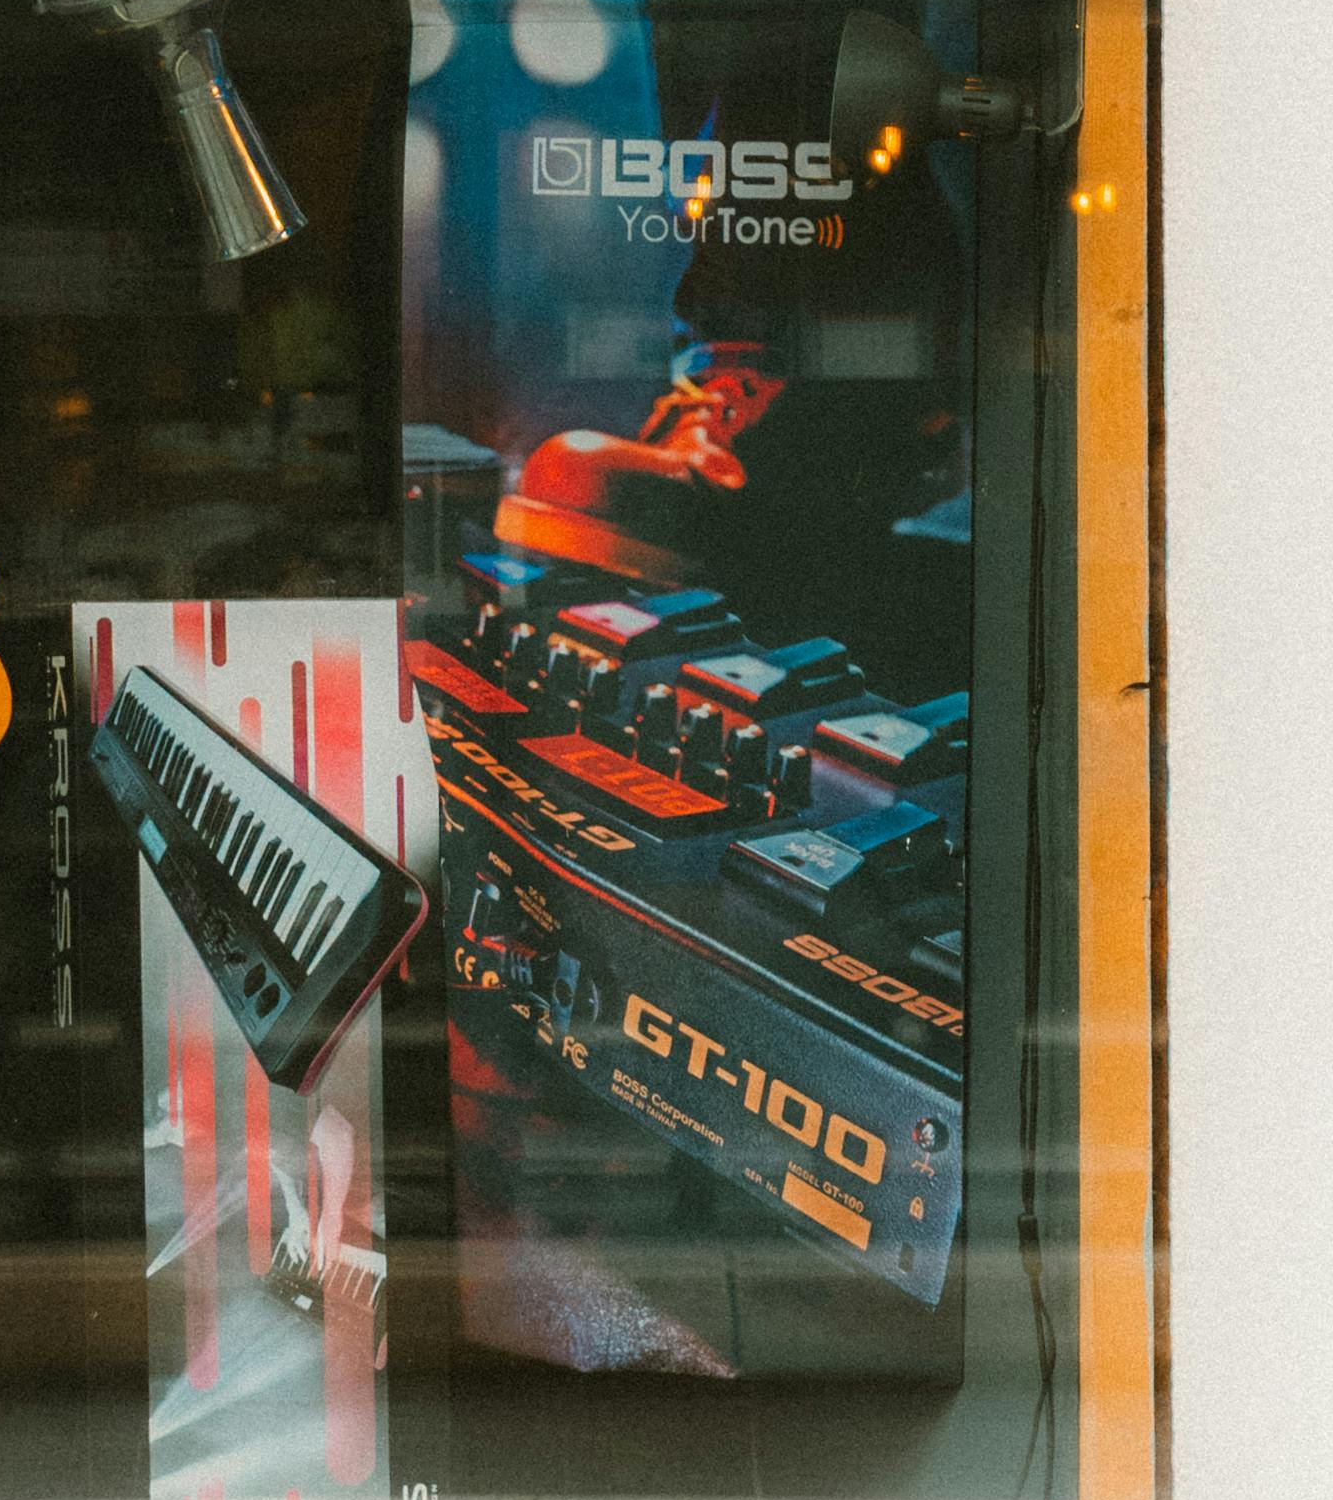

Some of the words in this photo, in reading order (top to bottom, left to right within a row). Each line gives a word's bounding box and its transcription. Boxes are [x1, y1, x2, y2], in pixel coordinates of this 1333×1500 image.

[600, 138, 854, 201] BOSS
[51, 655, 73, 1028] KROSS
[611, 1083, 634, 1104] MADE
[645, 1103, 677, 1130] TAIWAN
[612, 1067, 649, 1100] BOSS
[651, 1092, 725, 1147] Corporation
[622, 993, 886, 1186] GT-100
[787, 1160, 821, 1188] MODEL
[821, 1180, 865, 1213] GT-100
